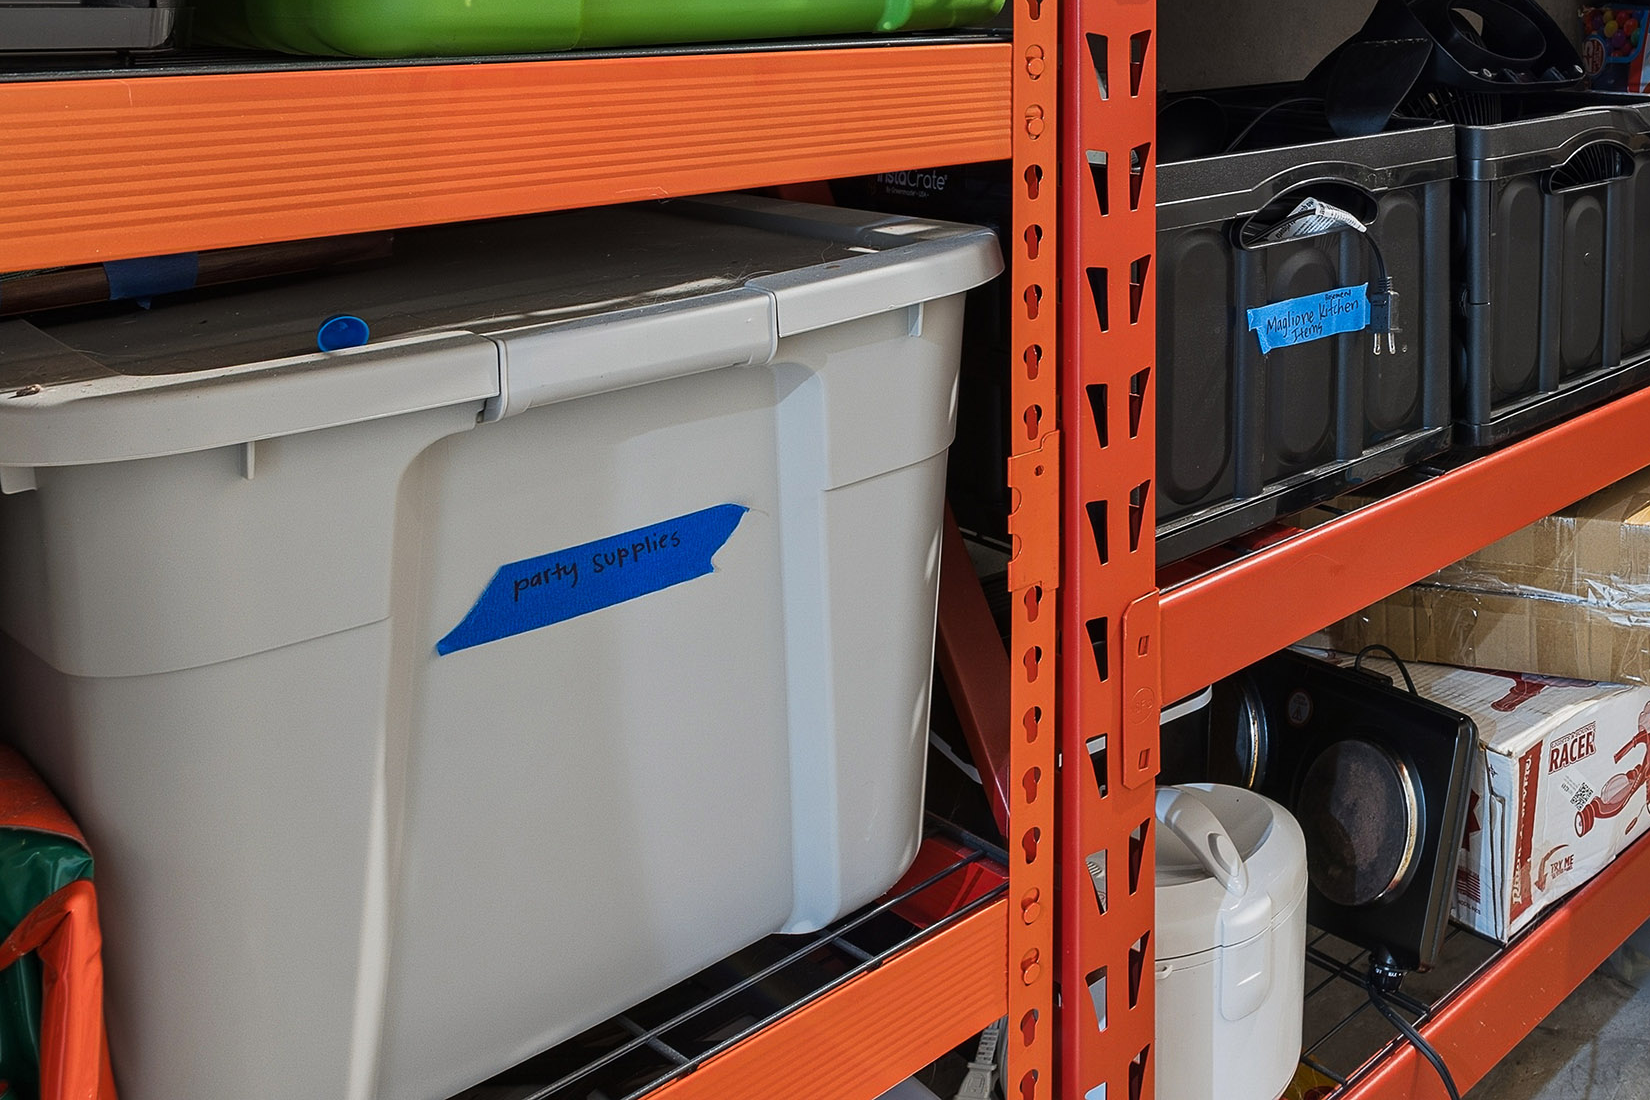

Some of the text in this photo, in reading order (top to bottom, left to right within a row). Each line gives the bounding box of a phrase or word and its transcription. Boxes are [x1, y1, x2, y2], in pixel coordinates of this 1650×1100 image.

[1267, 299, 1359, 338] Maglione Kitchen
[1292, 322, 1322, 343] Items
[514, 531, 681, 602] party supplies
[1549, 730, 1595, 773] RACER
[1550, 855, 1574, 873] TRY ME
